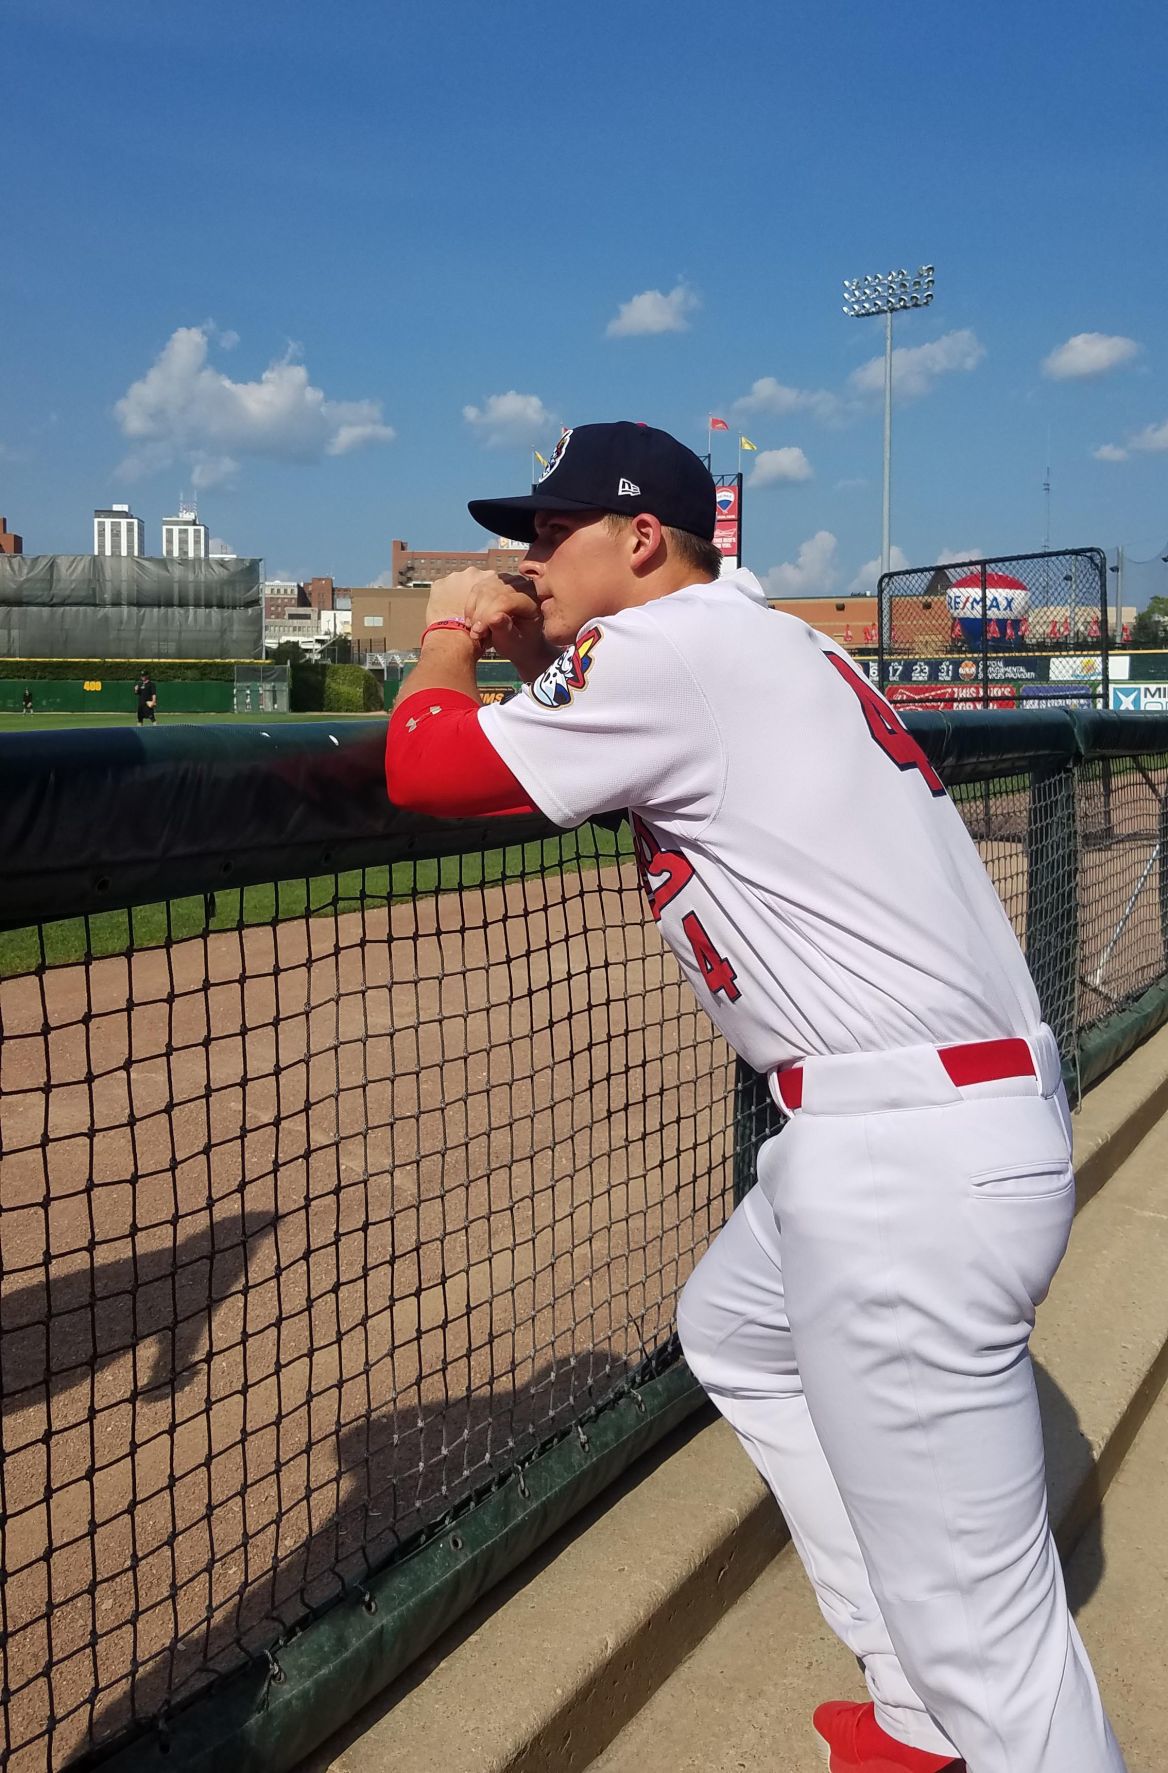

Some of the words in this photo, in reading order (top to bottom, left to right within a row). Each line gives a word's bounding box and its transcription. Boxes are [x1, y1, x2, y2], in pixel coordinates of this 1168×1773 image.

[946, 594, 1015, 612] RE/MAX
[888, 665, 903, 677] 17
[911, 665, 929, 677] 23
[1143, 686, 1168, 699] MI
[821, 650, 947, 798] 4
[682, 910, 742, 1003] 4
